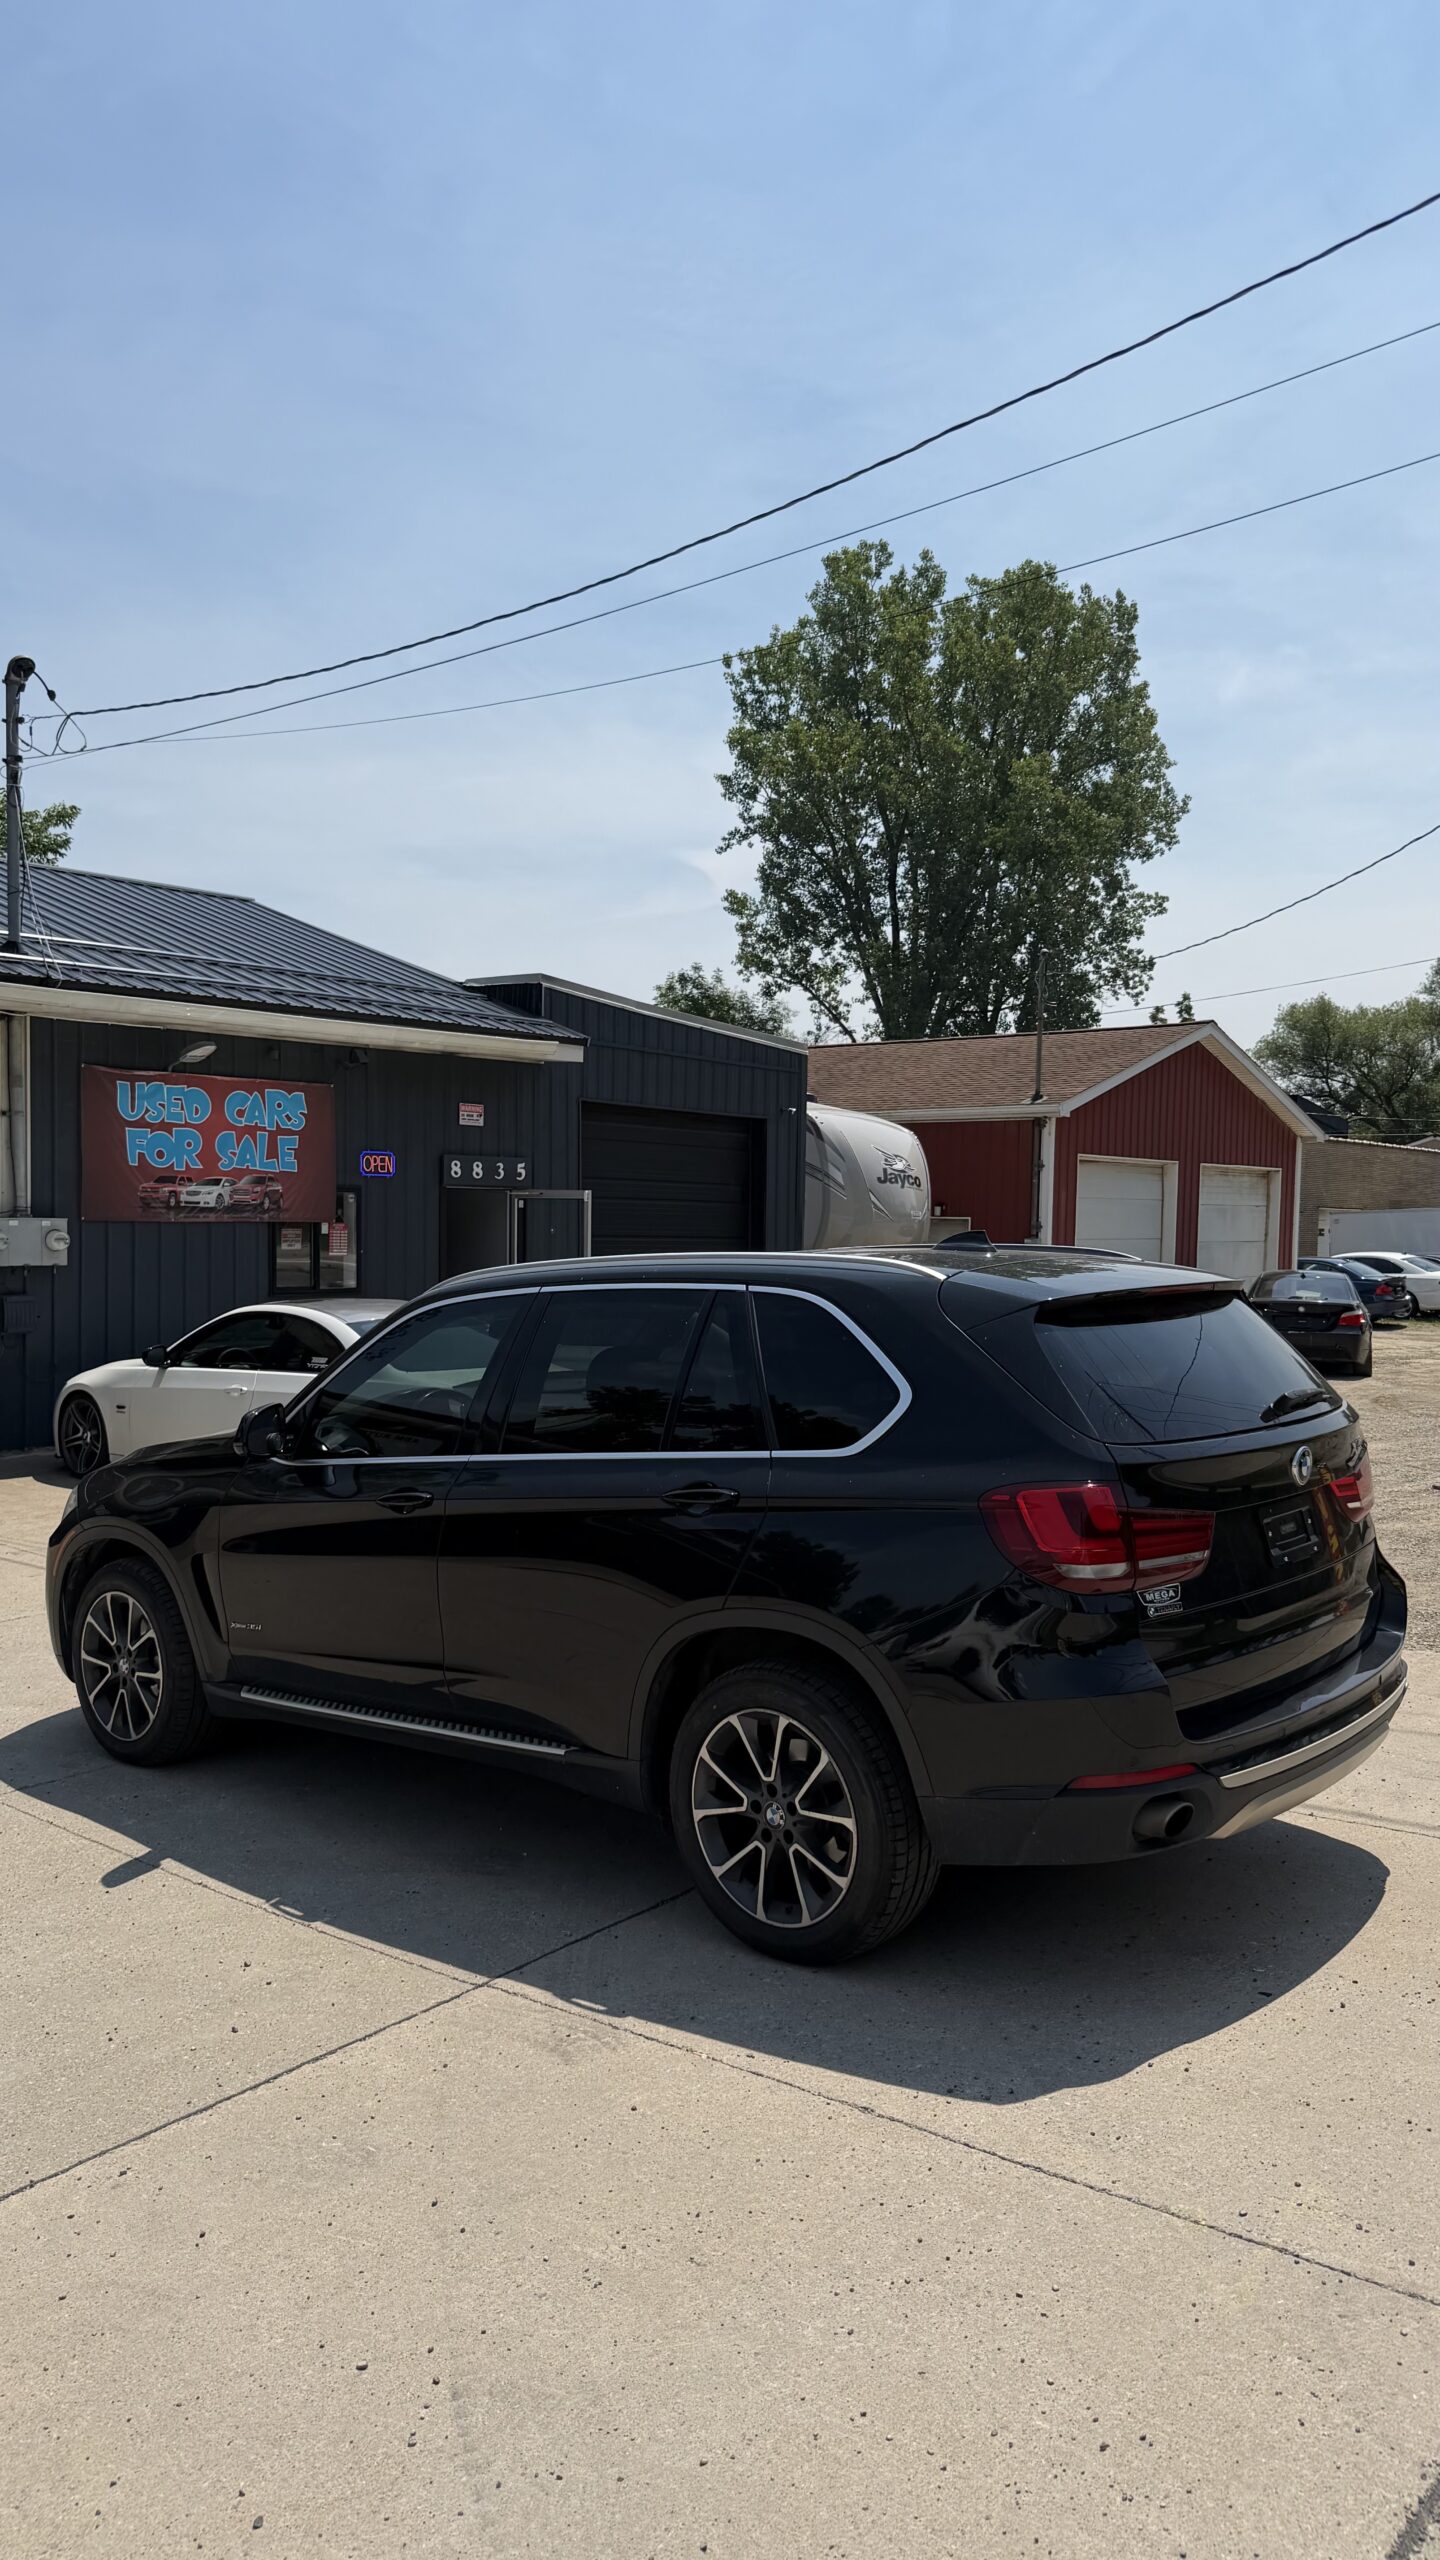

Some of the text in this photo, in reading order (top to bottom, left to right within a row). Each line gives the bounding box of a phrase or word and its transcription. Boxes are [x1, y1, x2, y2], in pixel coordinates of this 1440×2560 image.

[116, 1081, 308, 1130] USED CARS
[125, 1127, 299, 1172] FOR SALE
[363, 1155, 393, 1173] OPEN
[876, 1167, 922, 1189] Jayco
[1144, 1590, 1175, 1601] MEGA
